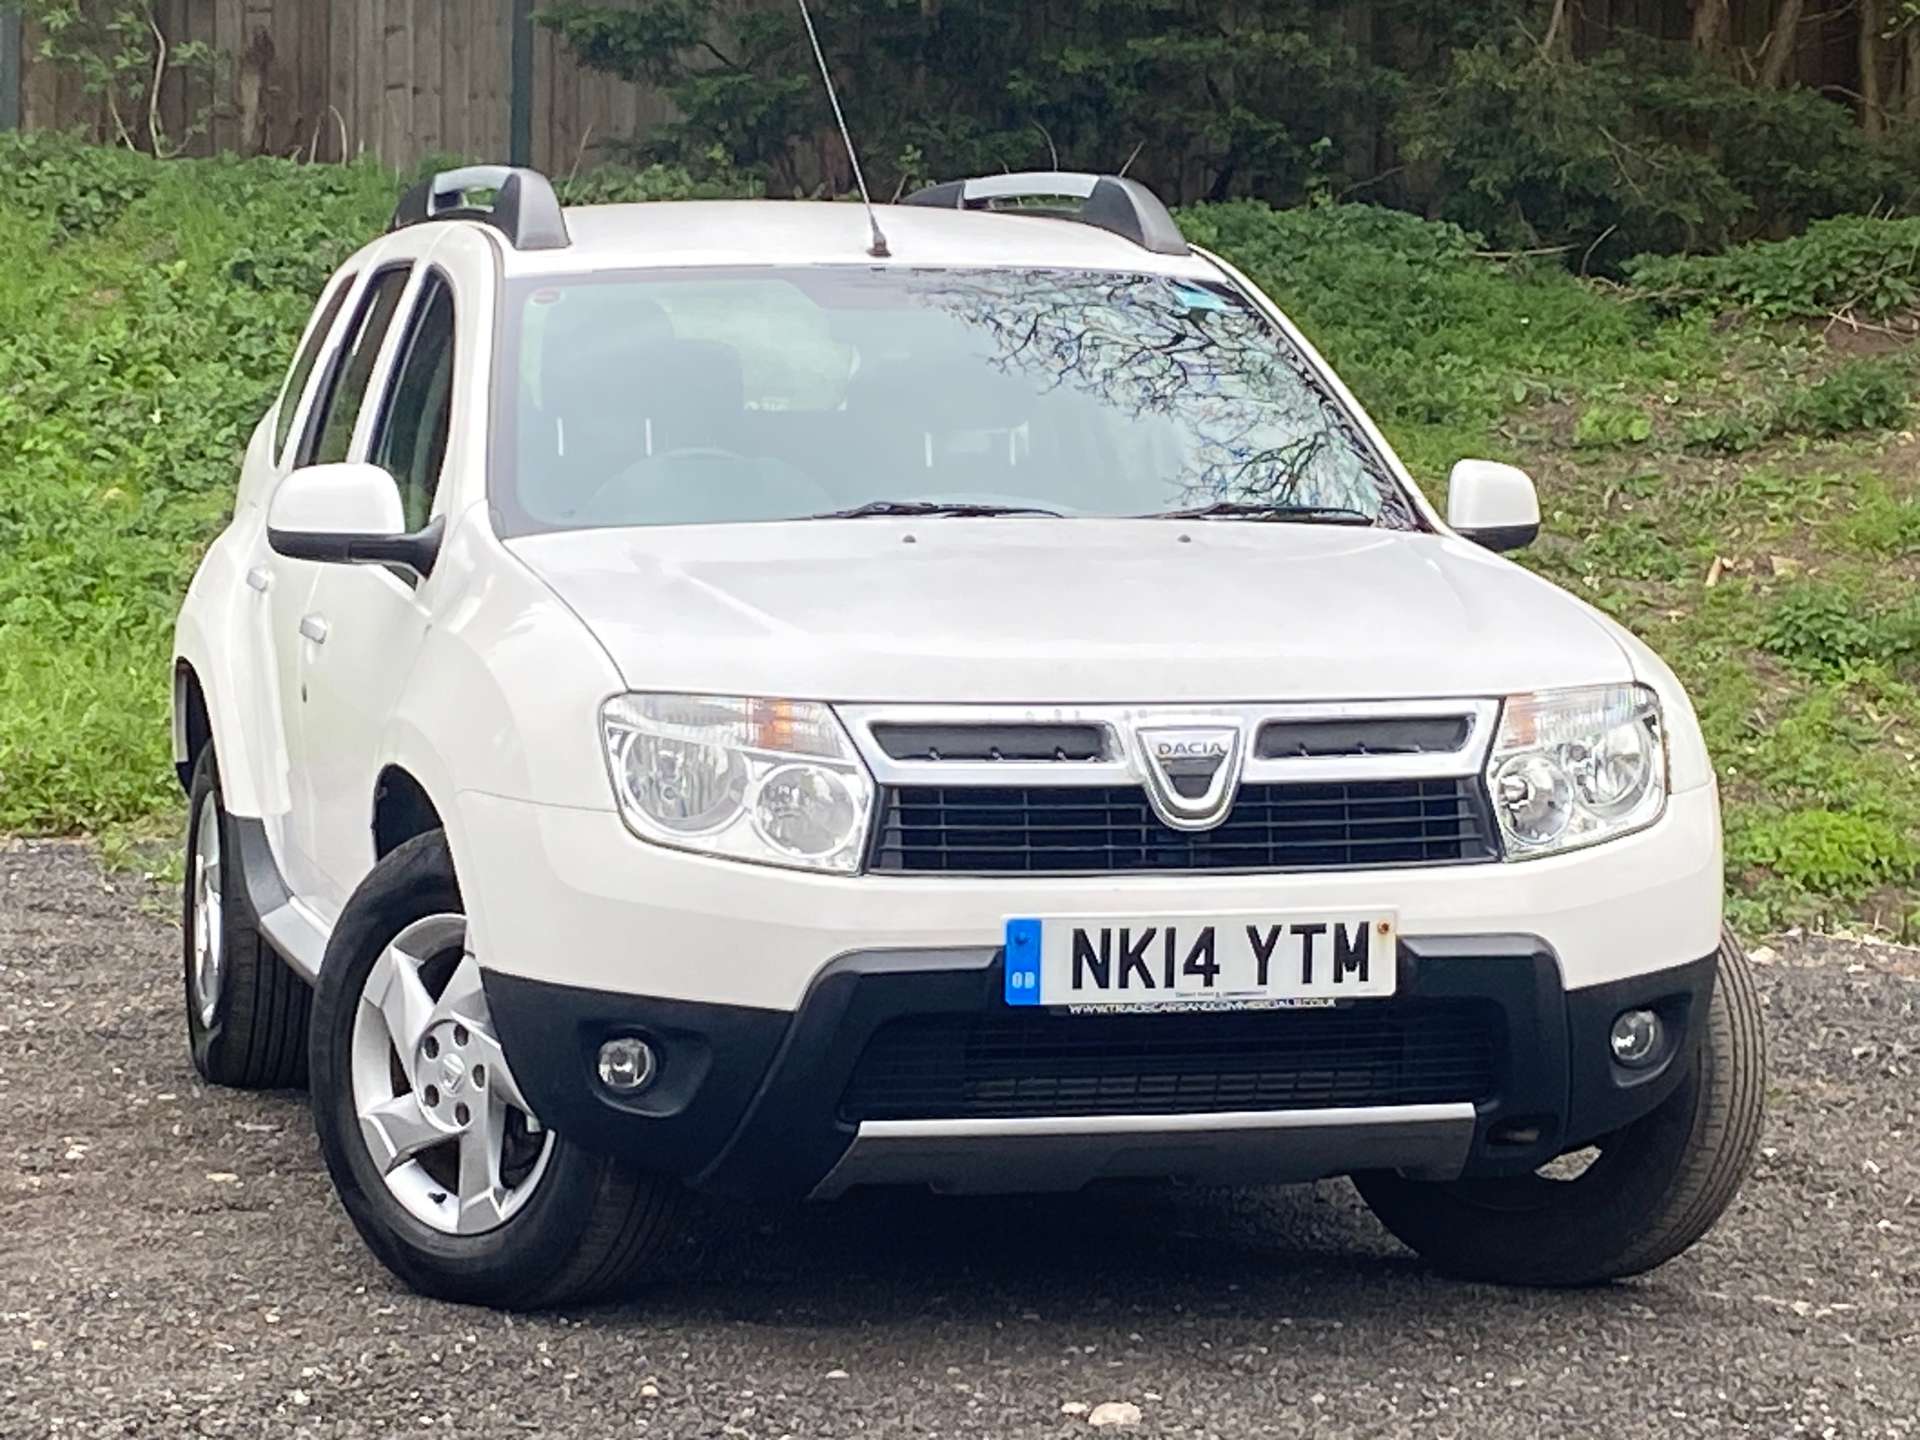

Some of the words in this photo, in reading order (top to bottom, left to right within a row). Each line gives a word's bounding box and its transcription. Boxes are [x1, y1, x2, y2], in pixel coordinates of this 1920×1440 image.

[1158, 743, 1228, 755] DACIA
[1072, 926, 1220, 990] NK14
[1246, 921, 1370, 986] YTM
